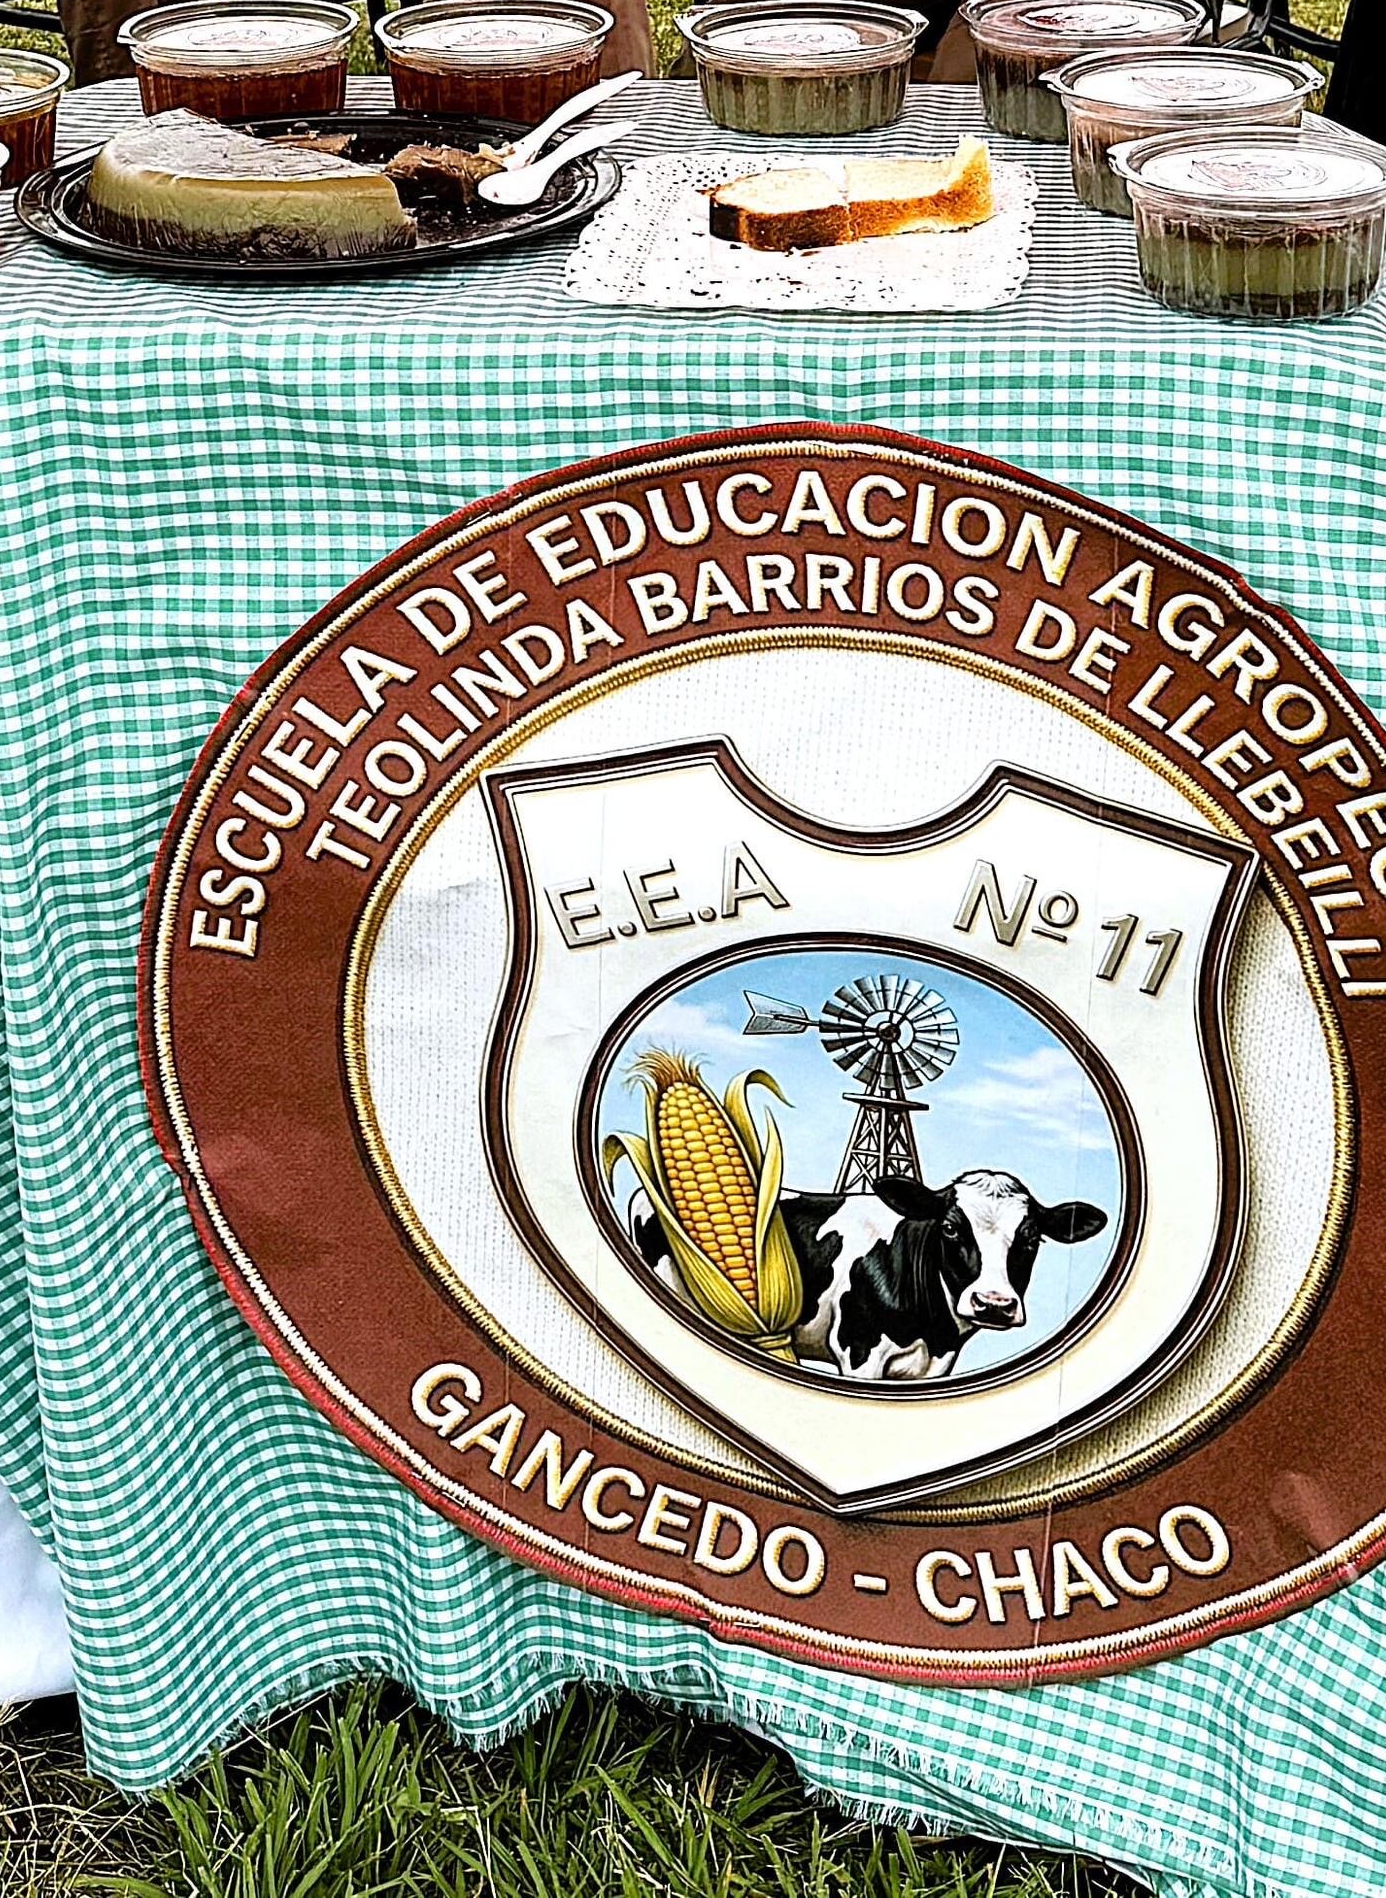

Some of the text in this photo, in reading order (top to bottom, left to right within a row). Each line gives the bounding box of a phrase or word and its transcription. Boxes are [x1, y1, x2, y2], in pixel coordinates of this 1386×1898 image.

[190, 644, 418, 959] ESCUELA
[395, 549, 529, 656] DE
[525, 470, 1082, 587] EDUCACION
[305, 598, 625, 870] TEOLINDA
[626, 551, 1001, 636] BARRIOS
[1014, 597, 1131, 696] DE
[543, 839, 790, 950] E.E.A
[1094, 913, 1182, 996] 11
[410, 1361, 1233, 1625] GANCEDO - CHACO
